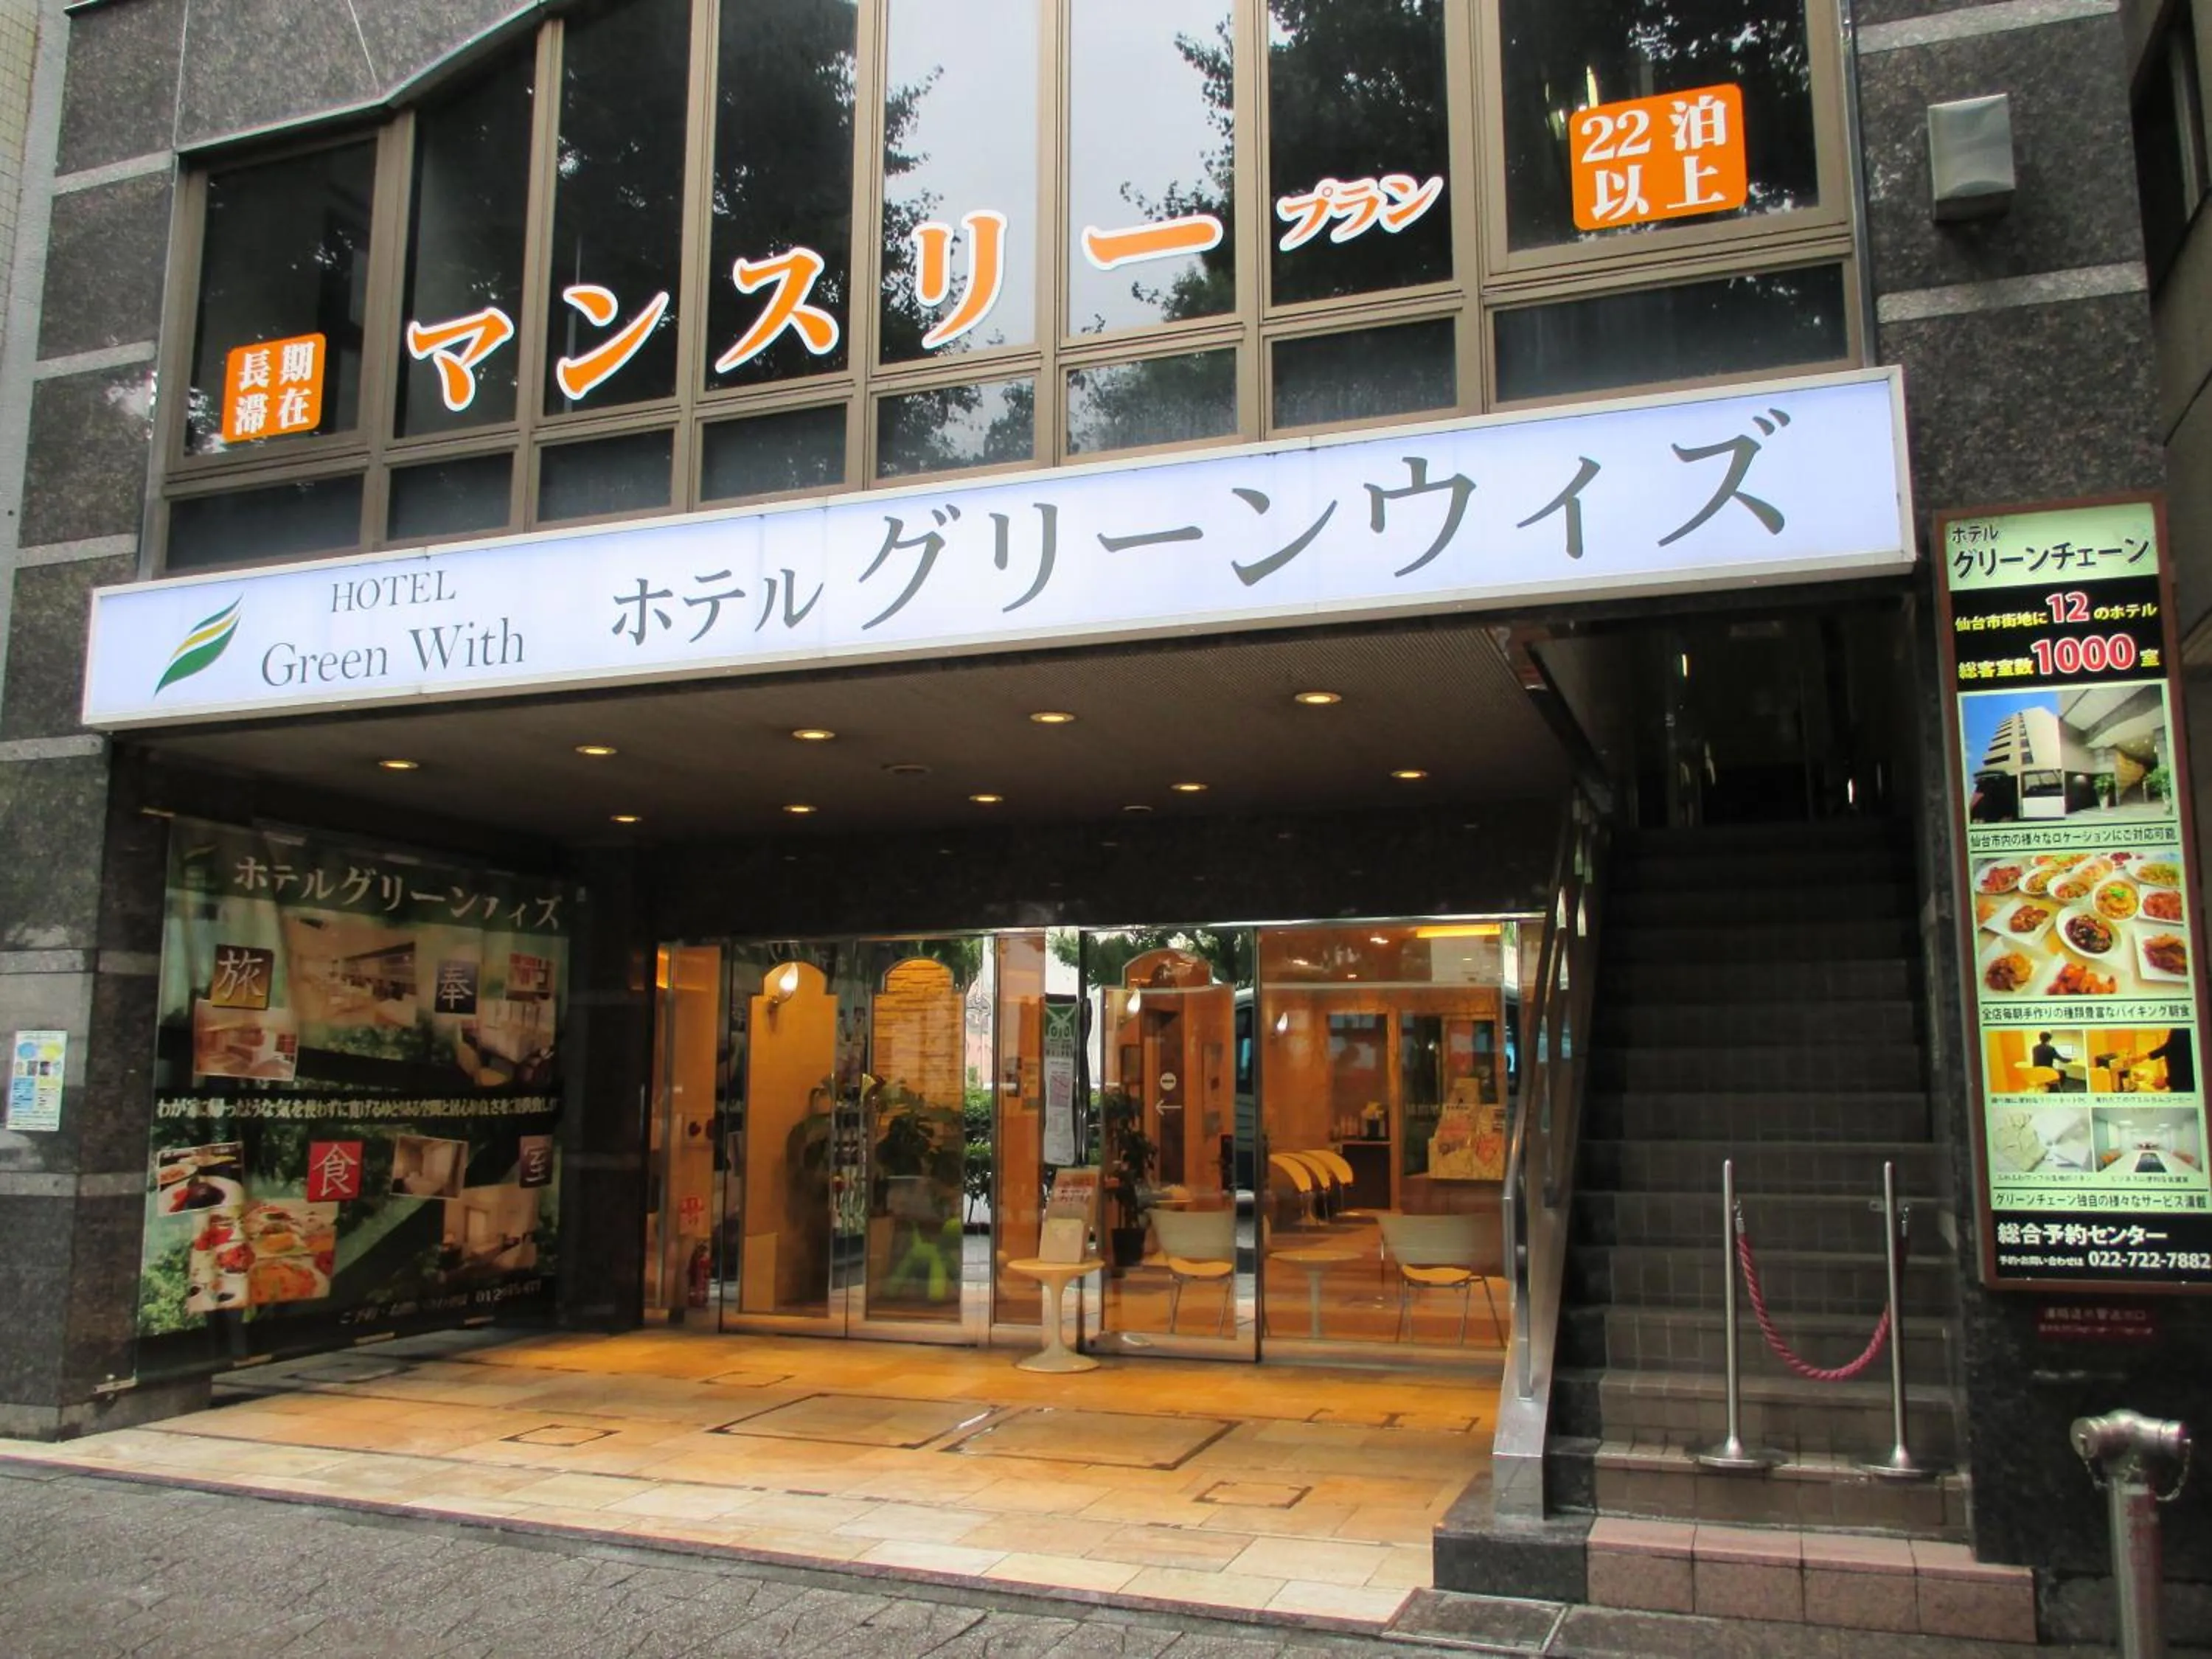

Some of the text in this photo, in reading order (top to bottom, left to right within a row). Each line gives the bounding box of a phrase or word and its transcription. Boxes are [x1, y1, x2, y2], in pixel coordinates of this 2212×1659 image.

[1580, 97, 1728, 165] 22泊
[1590, 153, 1727, 223] 以上
[236, 340, 316, 390] 長期
[234, 387, 311, 436] 滞在
[1952, 525, 1999, 544] ホテル
[1953, 538, 2149, 579] グリーンチェーン
[331, 569, 457, 613] HOTEL
[261, 616, 526, 687] Green With
[218, 949, 265, 1000] 旅
[313, 1144, 358, 1197] 食
[1997, 1221, 2168, 1246] 総合予約センター
[2087, 1250, 2212, 1269] 022-722-7882
